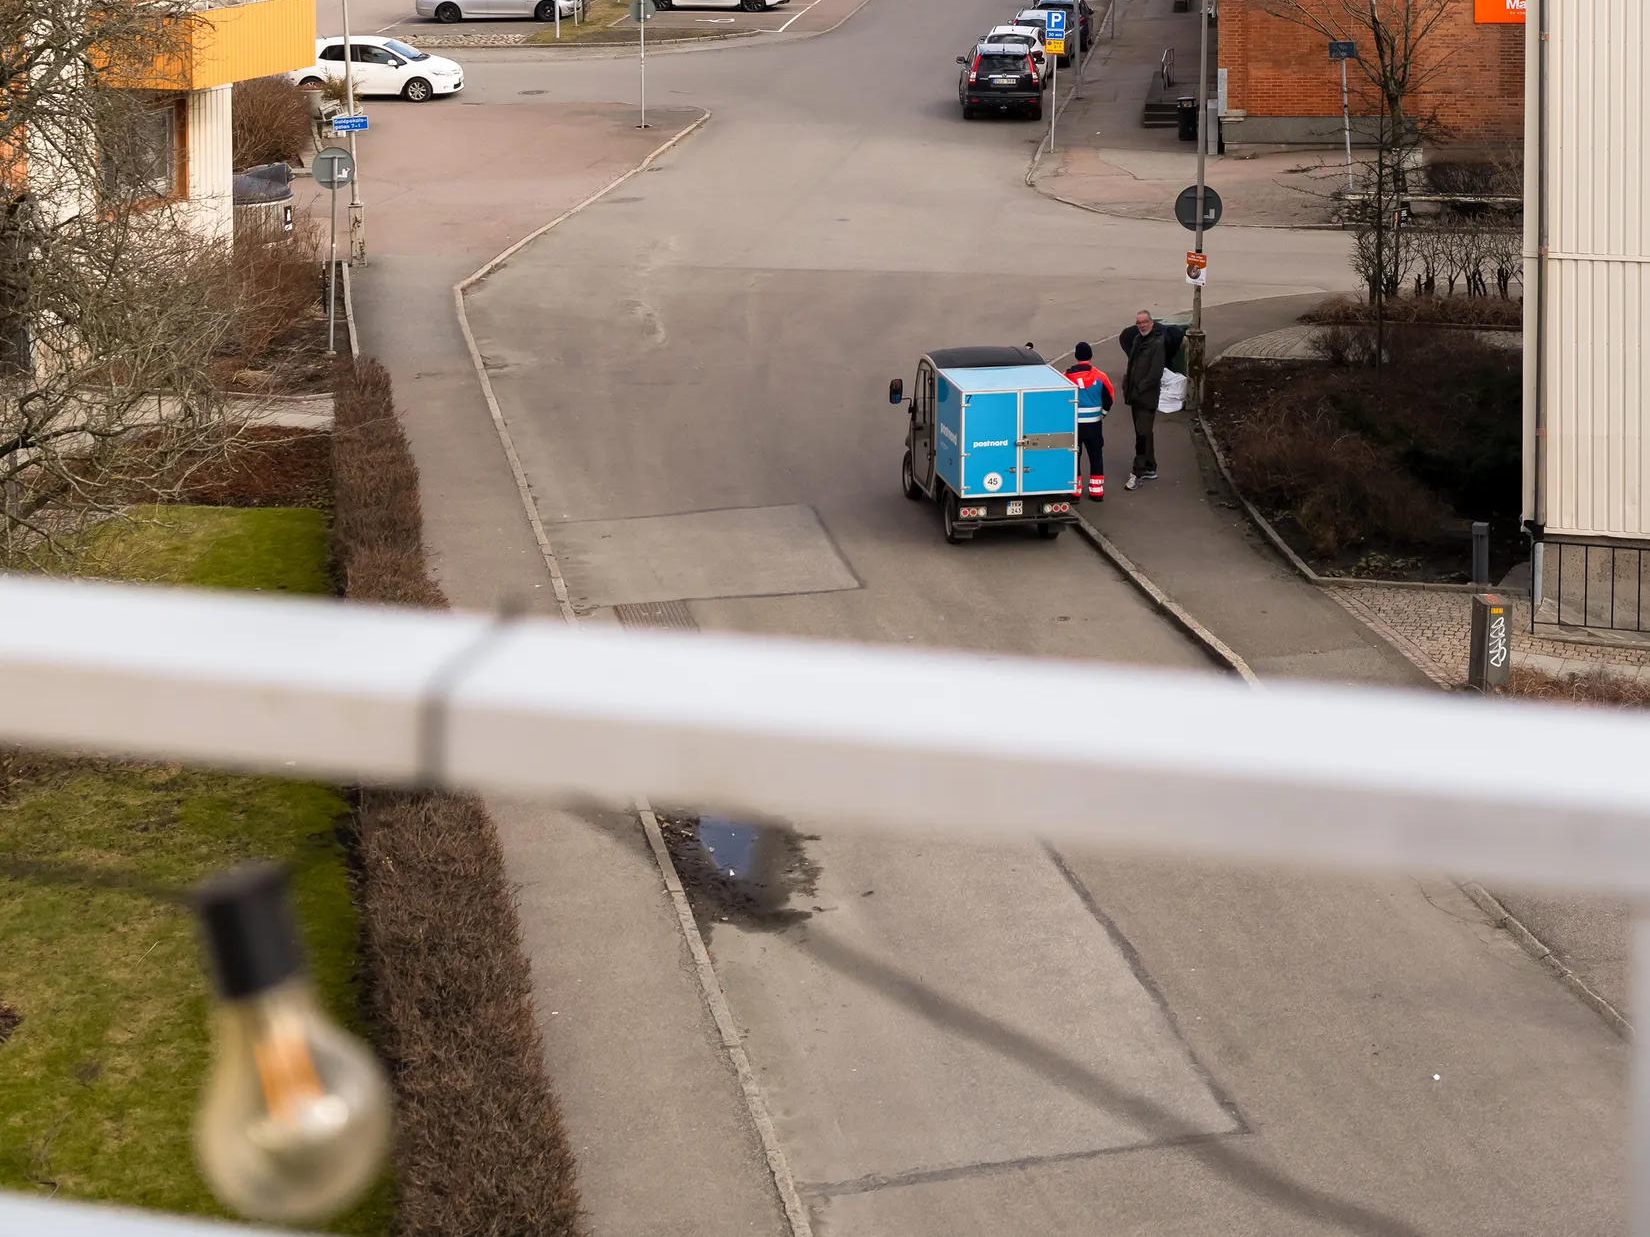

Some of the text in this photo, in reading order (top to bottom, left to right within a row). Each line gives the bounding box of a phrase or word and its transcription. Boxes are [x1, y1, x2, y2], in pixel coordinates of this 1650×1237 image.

[1051, 12, 1063, 28] P
[965, 394, 973, 404] 7
[973, 439, 1009, 449] postnord
[987, 477, 999, 486] 45
